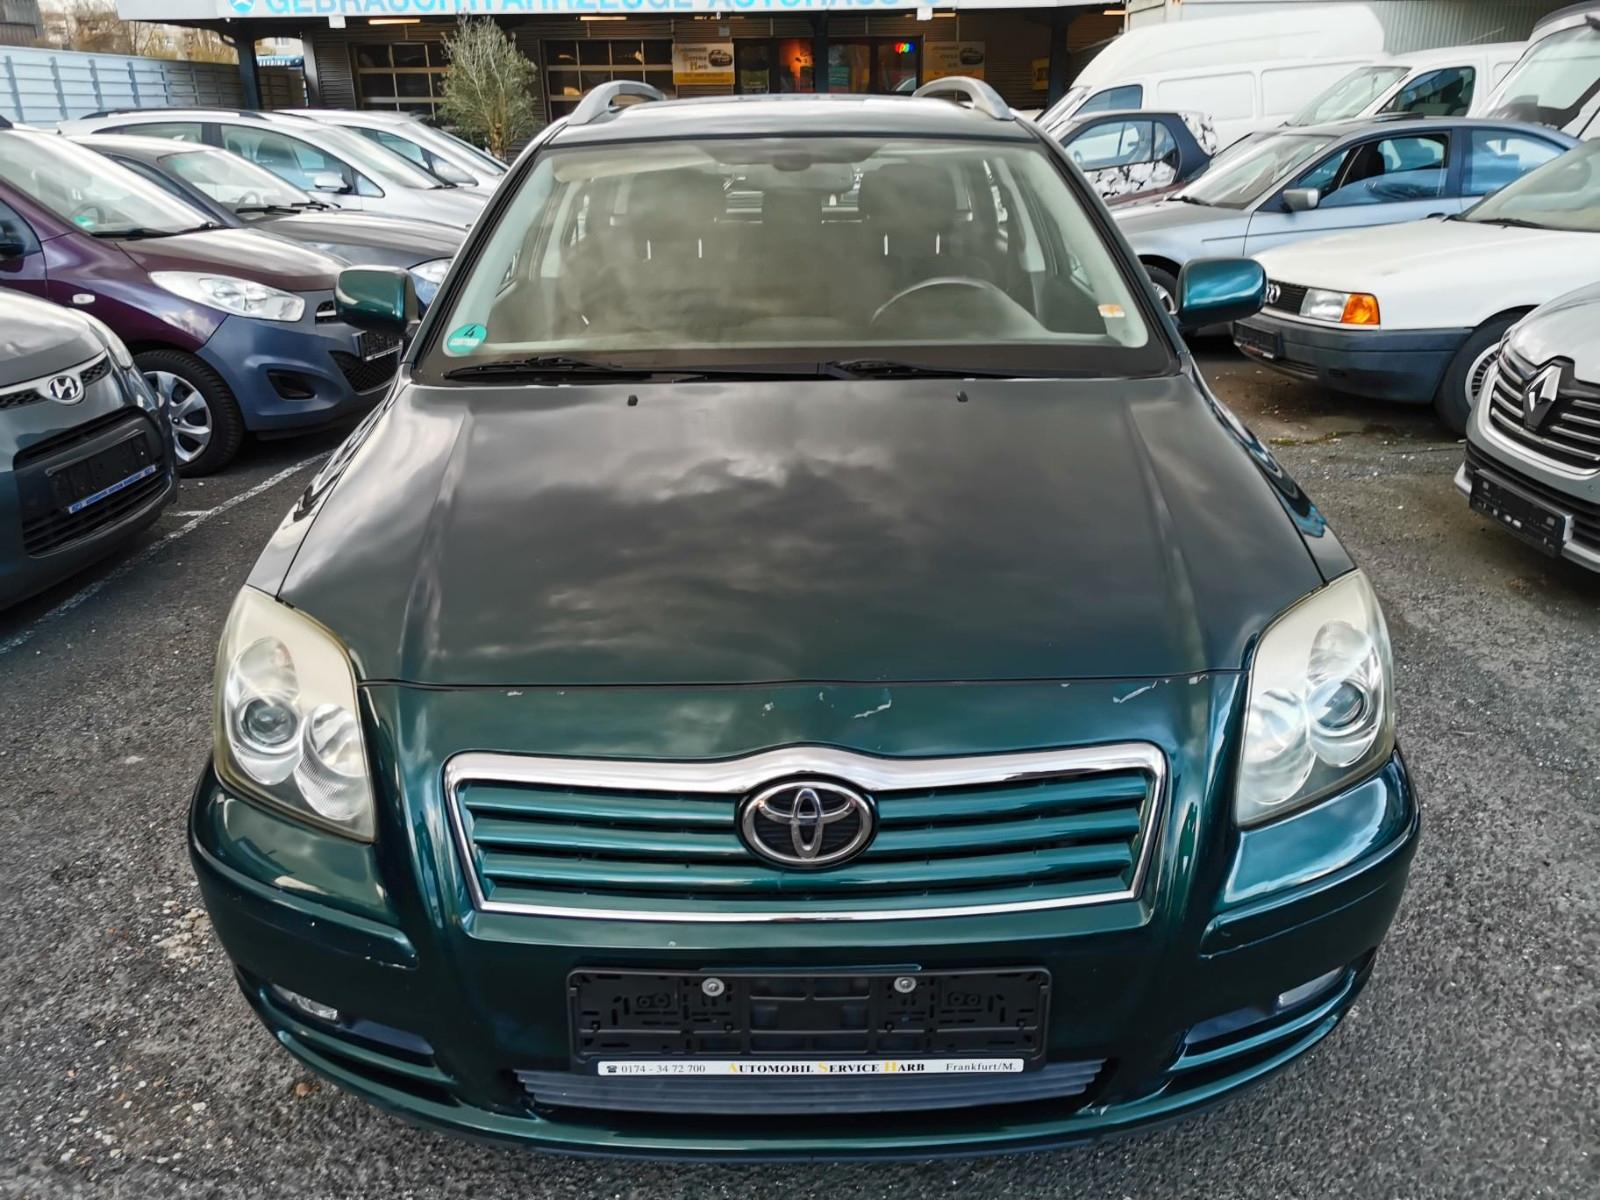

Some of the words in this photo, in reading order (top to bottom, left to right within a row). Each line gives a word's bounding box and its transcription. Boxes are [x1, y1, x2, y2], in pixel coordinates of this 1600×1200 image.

[463, 325, 477, 338] 4
[621, 1064, 646, 1073] 0174
[656, 1064, 668, 1073] 34
[672, 1064, 684, 1073] 72
[687, 1064, 706, 1073] 700
[729, 1062, 814, 1073] AUTOMOBIL
[818, 1061, 880, 1073] SERVICE
[884, 1061, 925, 1072] HARB
